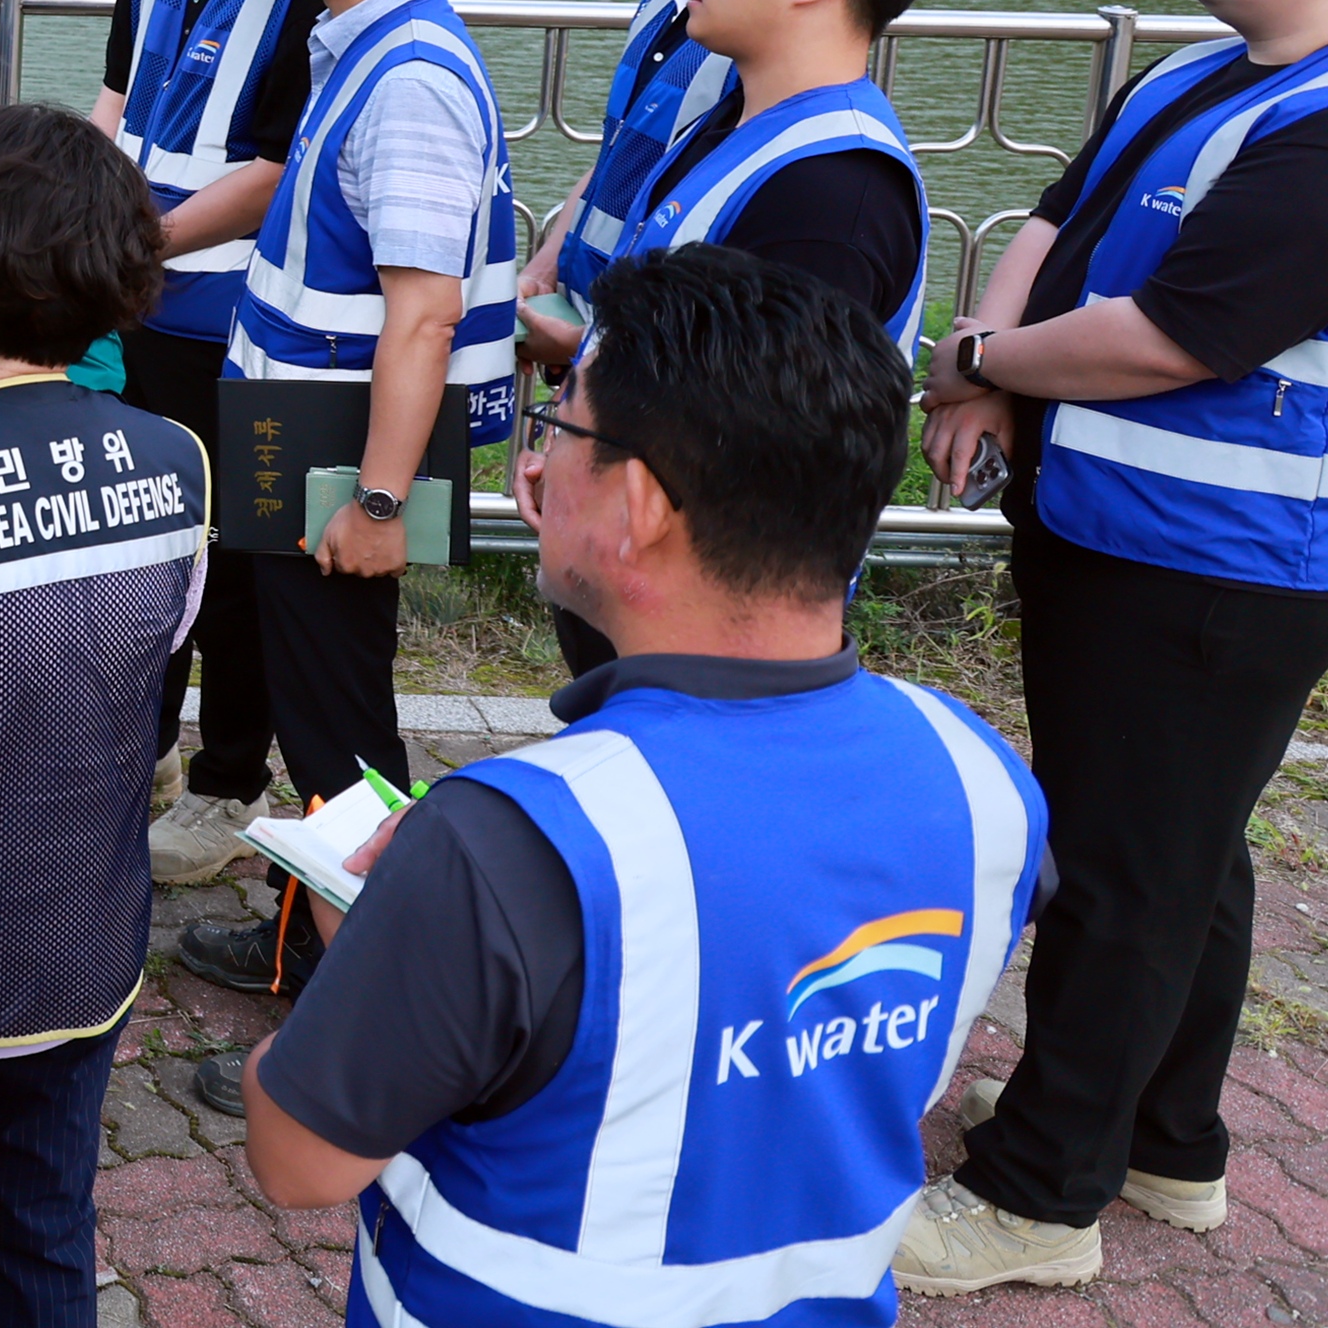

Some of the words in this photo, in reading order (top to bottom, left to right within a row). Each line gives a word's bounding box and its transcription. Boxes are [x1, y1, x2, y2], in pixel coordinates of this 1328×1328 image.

[492, 162, 511, 196] K
[1140, 193, 1152, 207] K
[1152, 199, 1182, 217] wate
[49, 437, 85, 483] 방
[102, 429, 135, 473] 위
[34, 489, 100, 541] CIVIL
[100, 472, 185, 528] DEFENSE
[716, 1019, 764, 1086] K
[786, 994, 939, 1078] water
